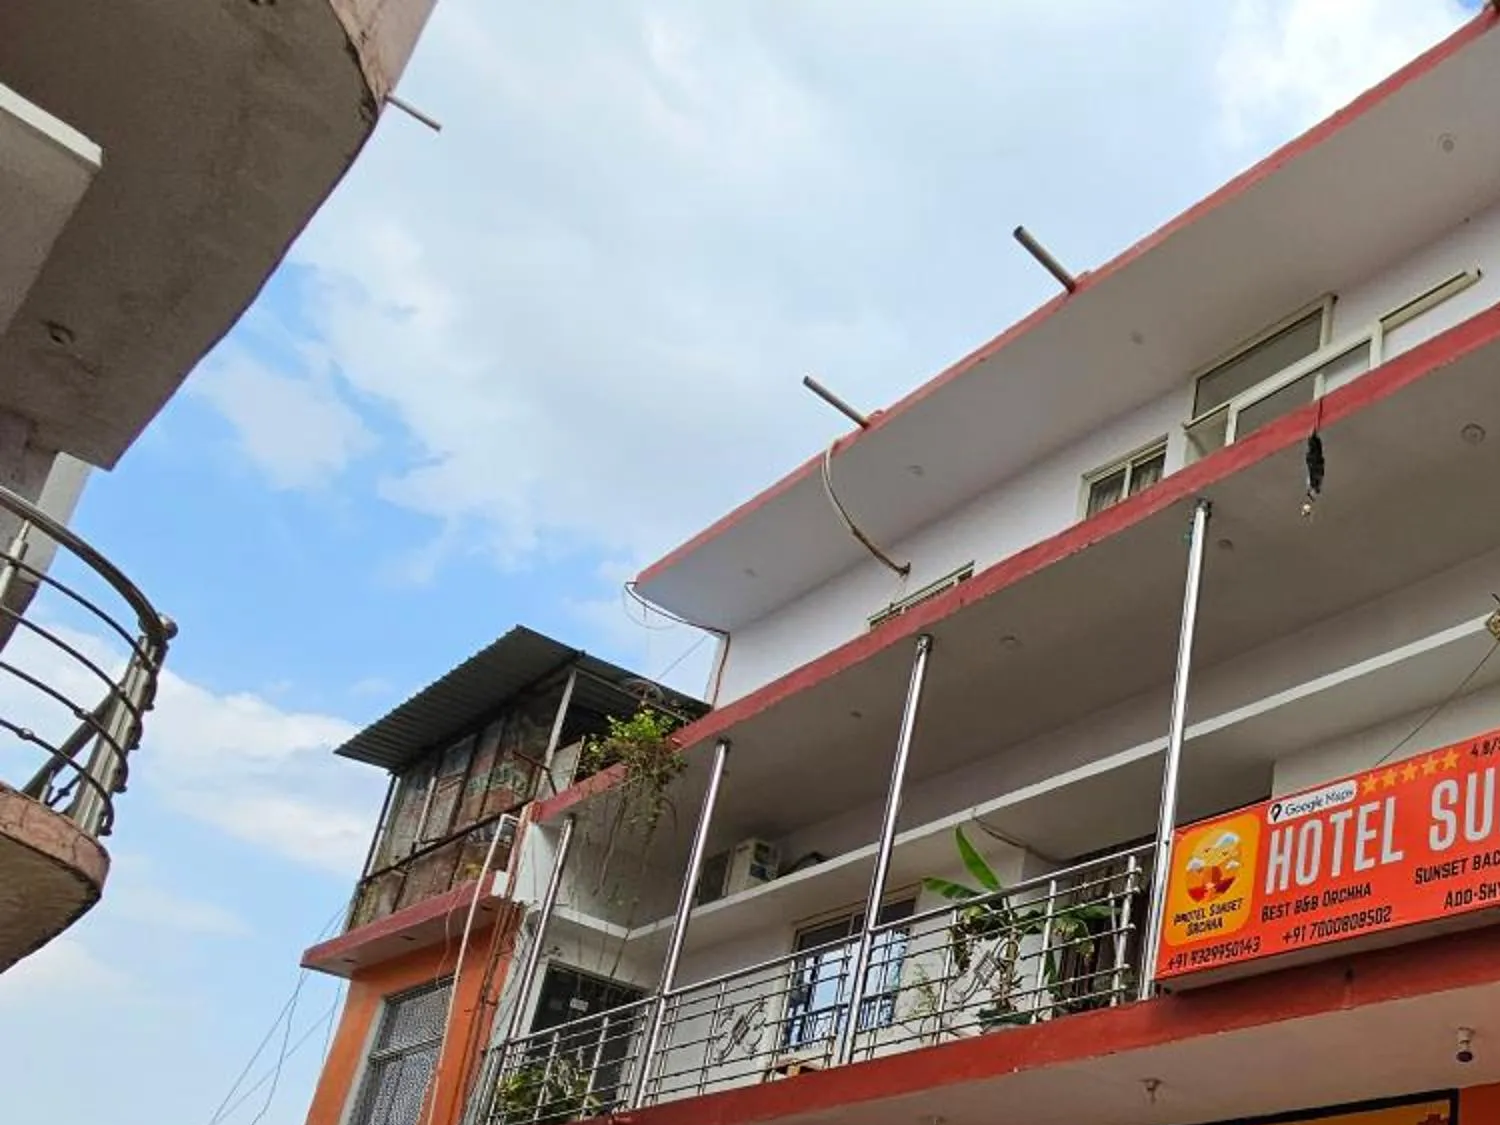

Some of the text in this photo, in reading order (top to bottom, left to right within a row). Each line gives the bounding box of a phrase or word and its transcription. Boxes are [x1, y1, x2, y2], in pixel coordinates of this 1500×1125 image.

[1285, 795, 1324, 816] Google
[1265, 796, 1404, 895] HOTEL
[1415, 857, 1468, 885] SUNSET
[1261, 902, 1291, 922] BEST
[1322, 883, 1372, 909] ORCHHA
[1282, 924, 1306, 944] +91
